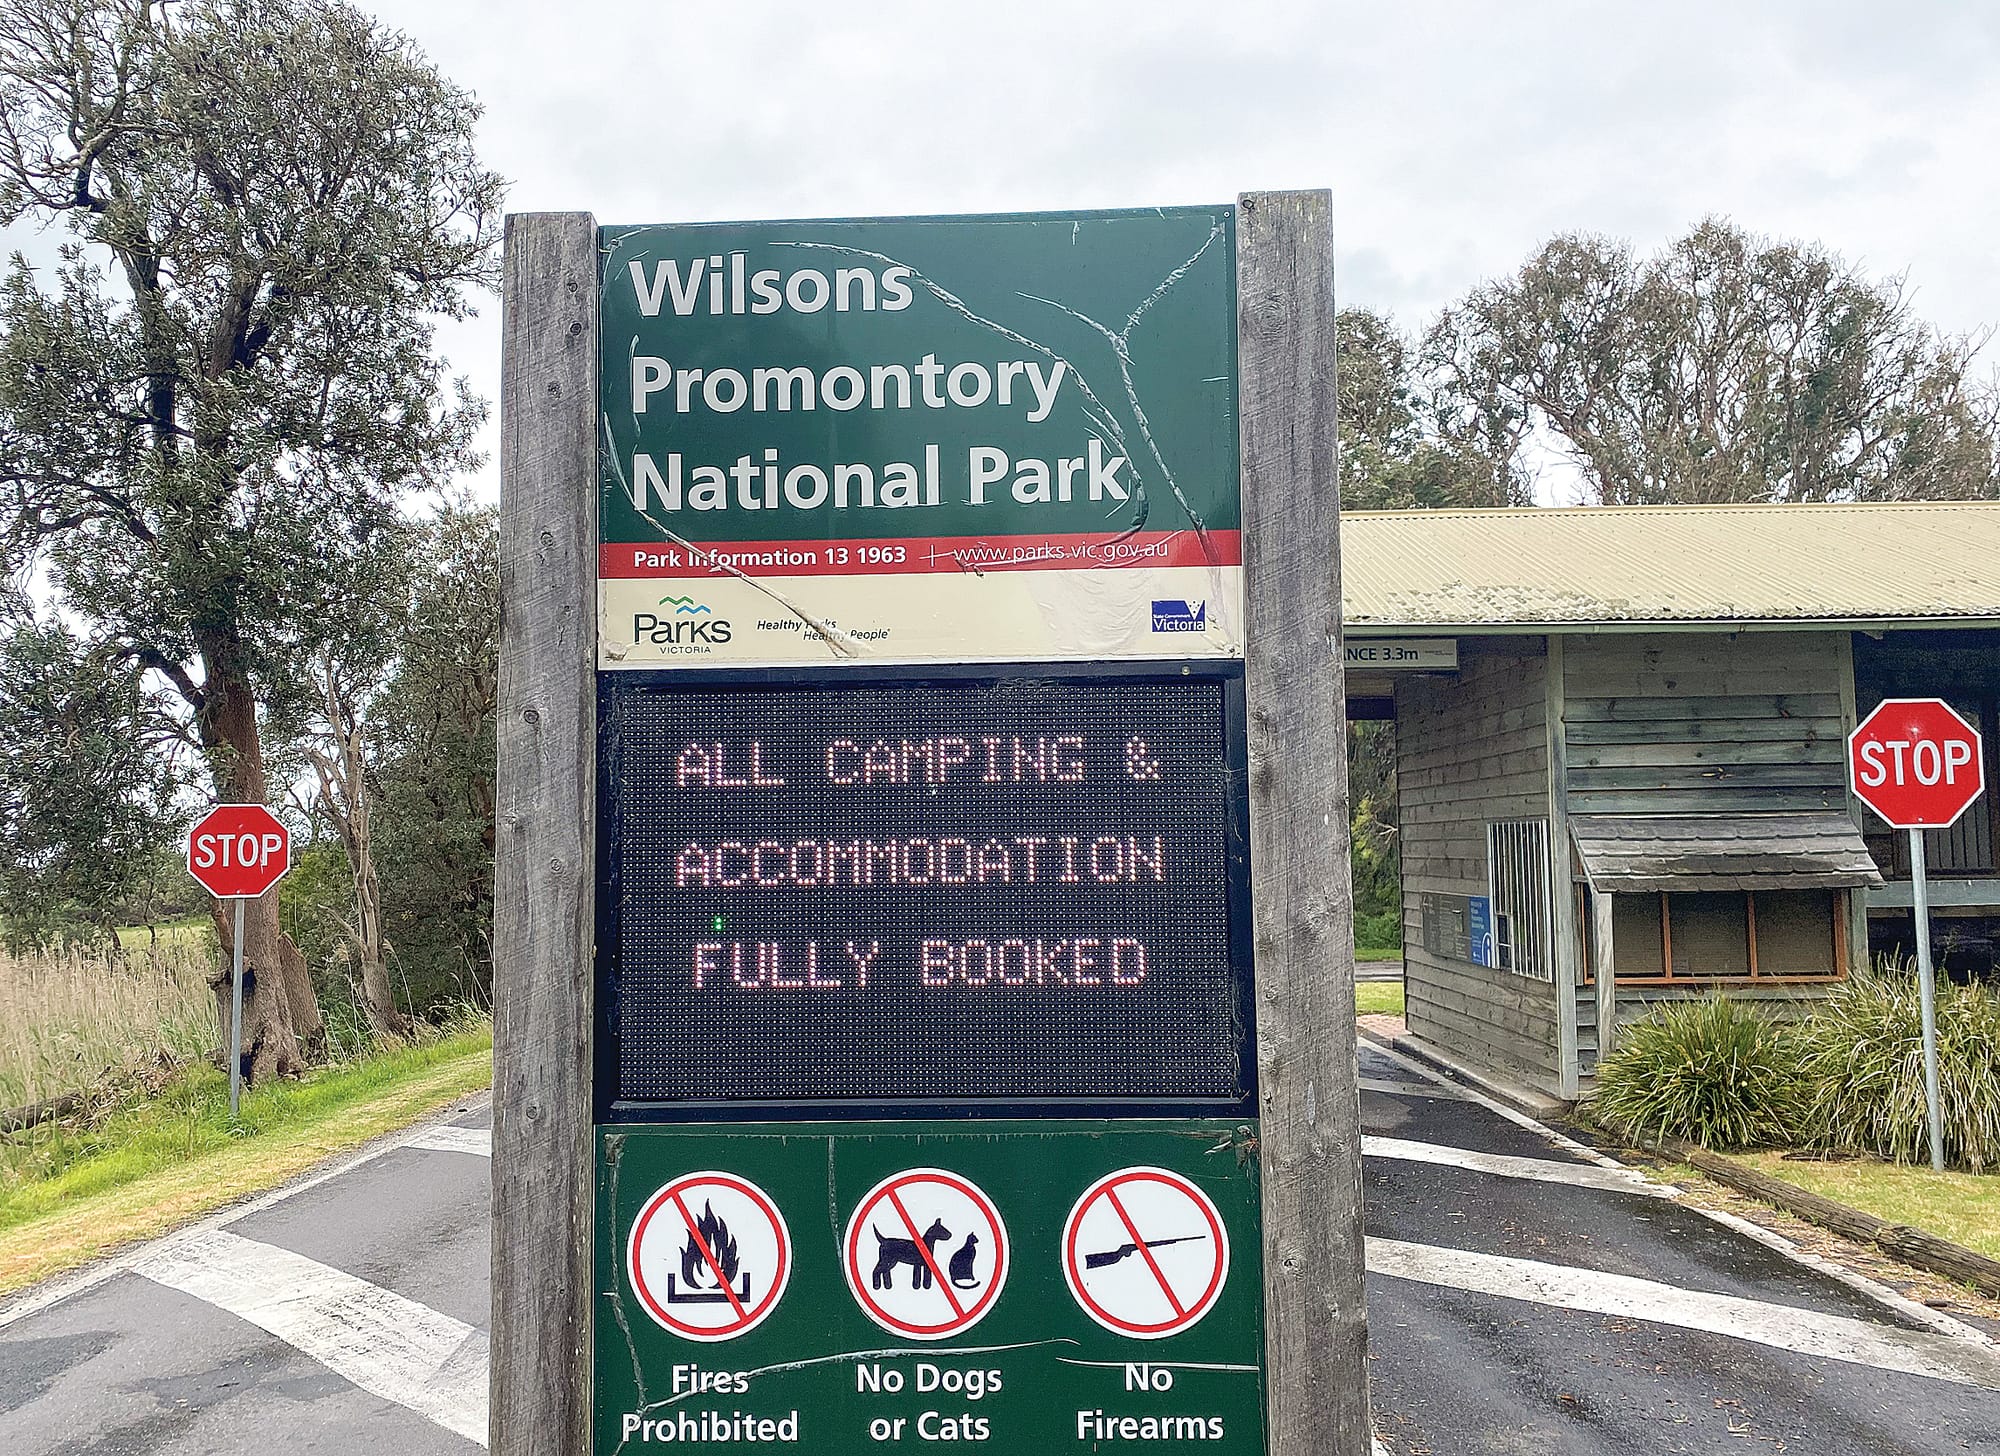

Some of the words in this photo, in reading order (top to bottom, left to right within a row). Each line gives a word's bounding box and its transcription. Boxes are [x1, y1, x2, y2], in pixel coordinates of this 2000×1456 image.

[629, 253, 914, 318] Wilsons
[632, 353, 1066, 422] Promontory
[632, 444, 940, 512] National
[969, 439, 1130, 505] Park
[634, 550, 682, 568] Park
[688, 548, 816, 567] Information
[824, 547, 848, 565] 13
[856, 546, 906, 564] 1963
[953, 541, 1168, 565] www.parks.vic.gov.au
[634, 614, 731, 645] Parks
[757, 619, 802, 632] Healthy
[805, 619, 837, 630] Pks
[1153, 618, 1205, 631] Victoria
[659, 647, 711, 655] VICTORIA
[1343, 648, 1377, 660] NCE
[1382, 647, 1418, 660] 3.3m
[676, 741, 785, 787] ALL
[826, 736, 1085, 784] CAMPING
[1125, 736, 1160, 781] &
[1860, 739, 1971, 786] STOP
[194, 833, 282, 868] STOP
[675, 836, 1165, 887] ACCOMMODATION
[693, 939, 879, 989] FULLY
[921, 937, 1147, 987] BOOKED
[672, 1364, 749, 1393] Fires
[857, 1363, 904, 1393] No
[916, 1363, 1002, 1400] Dogs
[1125, 1362, 1173, 1391] No
[622, 1410, 798, 1442] Prohibited
[869, 1416, 906, 1441] or
[917, 1411, 990, 1441] Cats
[1077, 1410, 1224, 1440] Firearms
